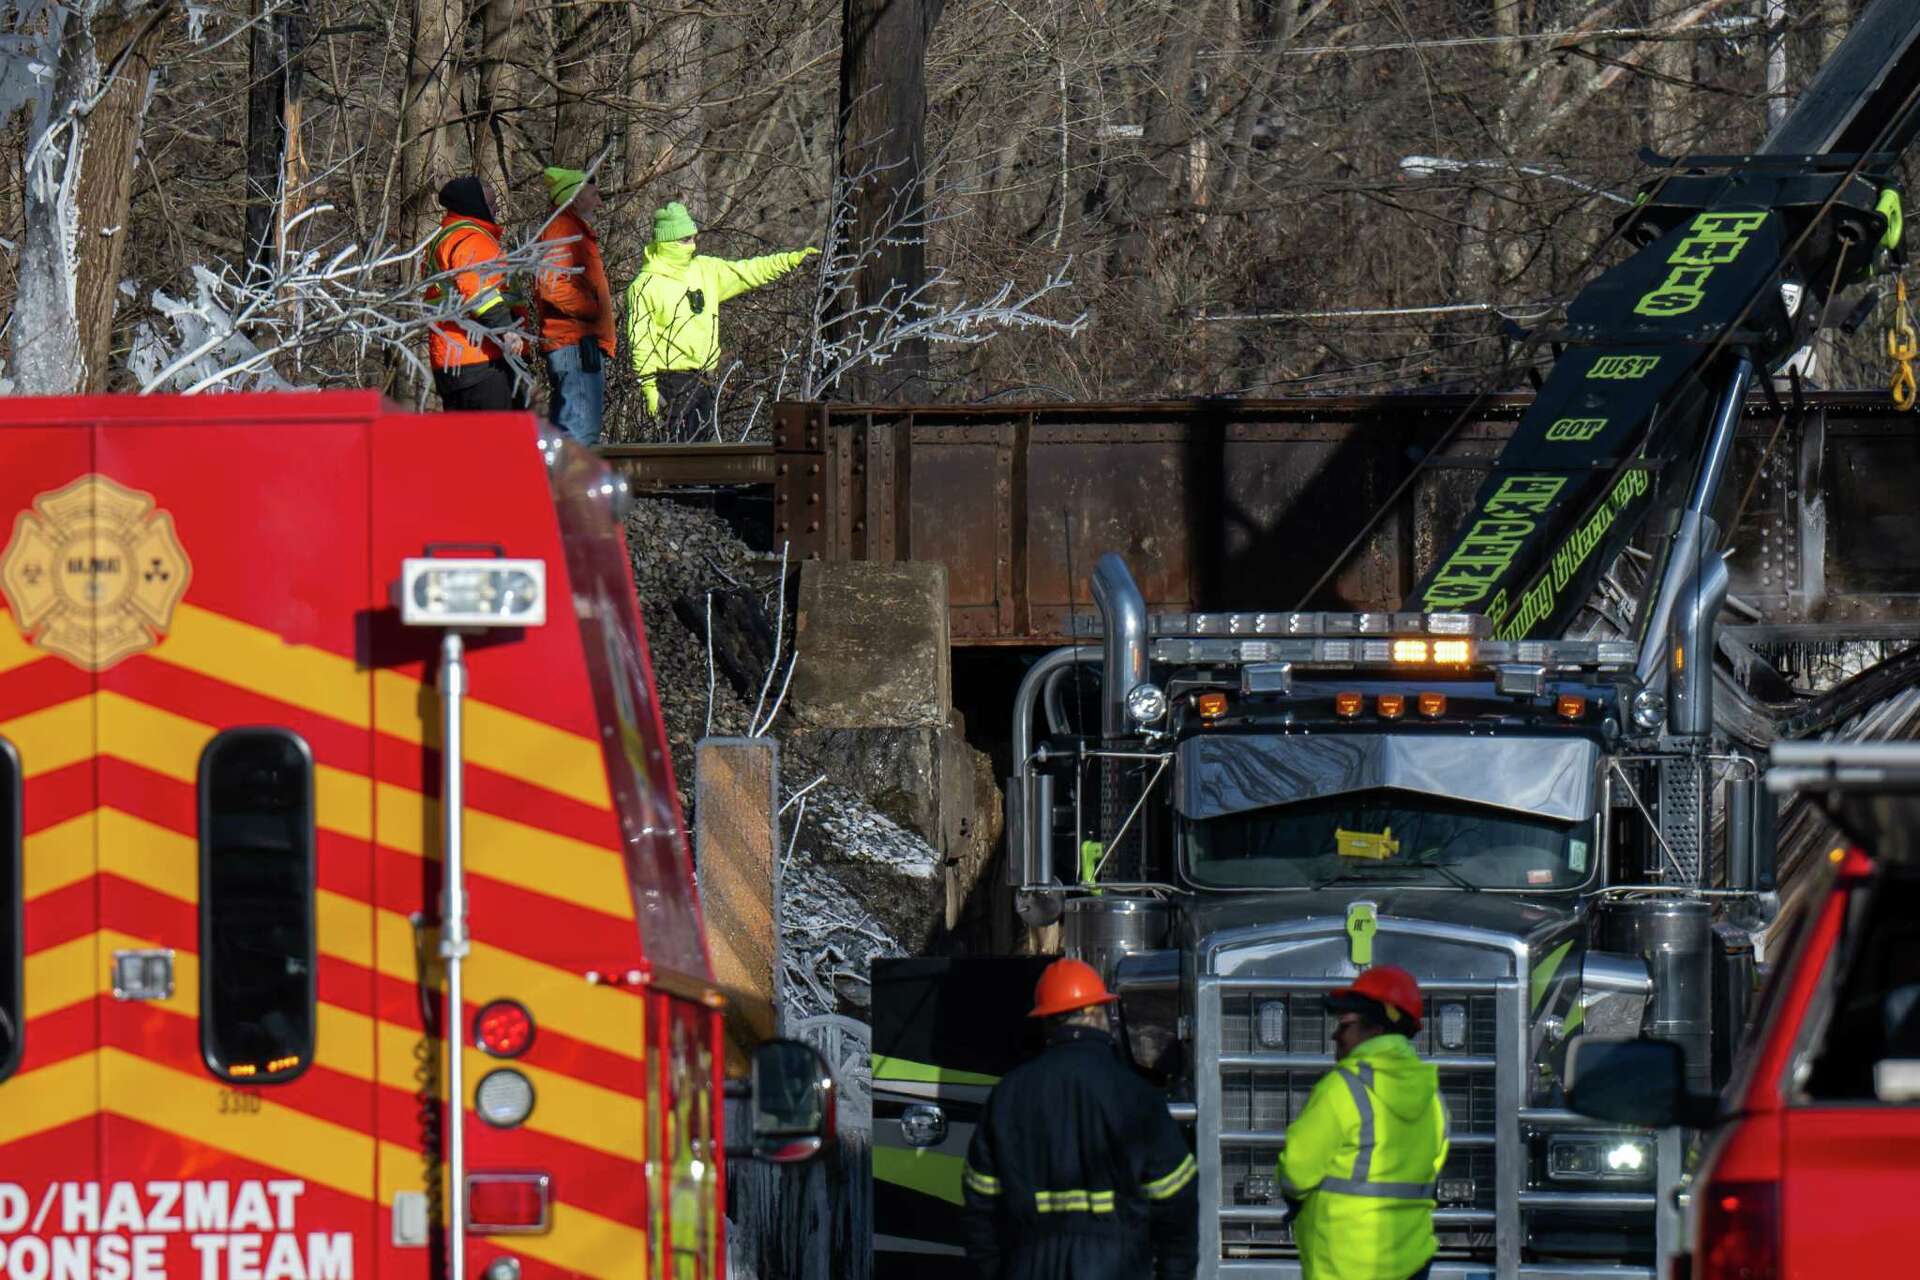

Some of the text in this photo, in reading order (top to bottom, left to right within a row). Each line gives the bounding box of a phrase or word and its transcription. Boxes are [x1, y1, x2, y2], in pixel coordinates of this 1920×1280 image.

[1633, 211, 1768, 316] THIS
[1585, 355, 1661, 379] JUST
[1545, 418, 1608, 441] GOT
[1422, 476, 1568, 614] EXPENS
[1488, 573, 1554, 641] wing
[0, 1181, 305, 1233] D/HAZMAT
[0, 1232, 354, 1280] ONSE TEAM
